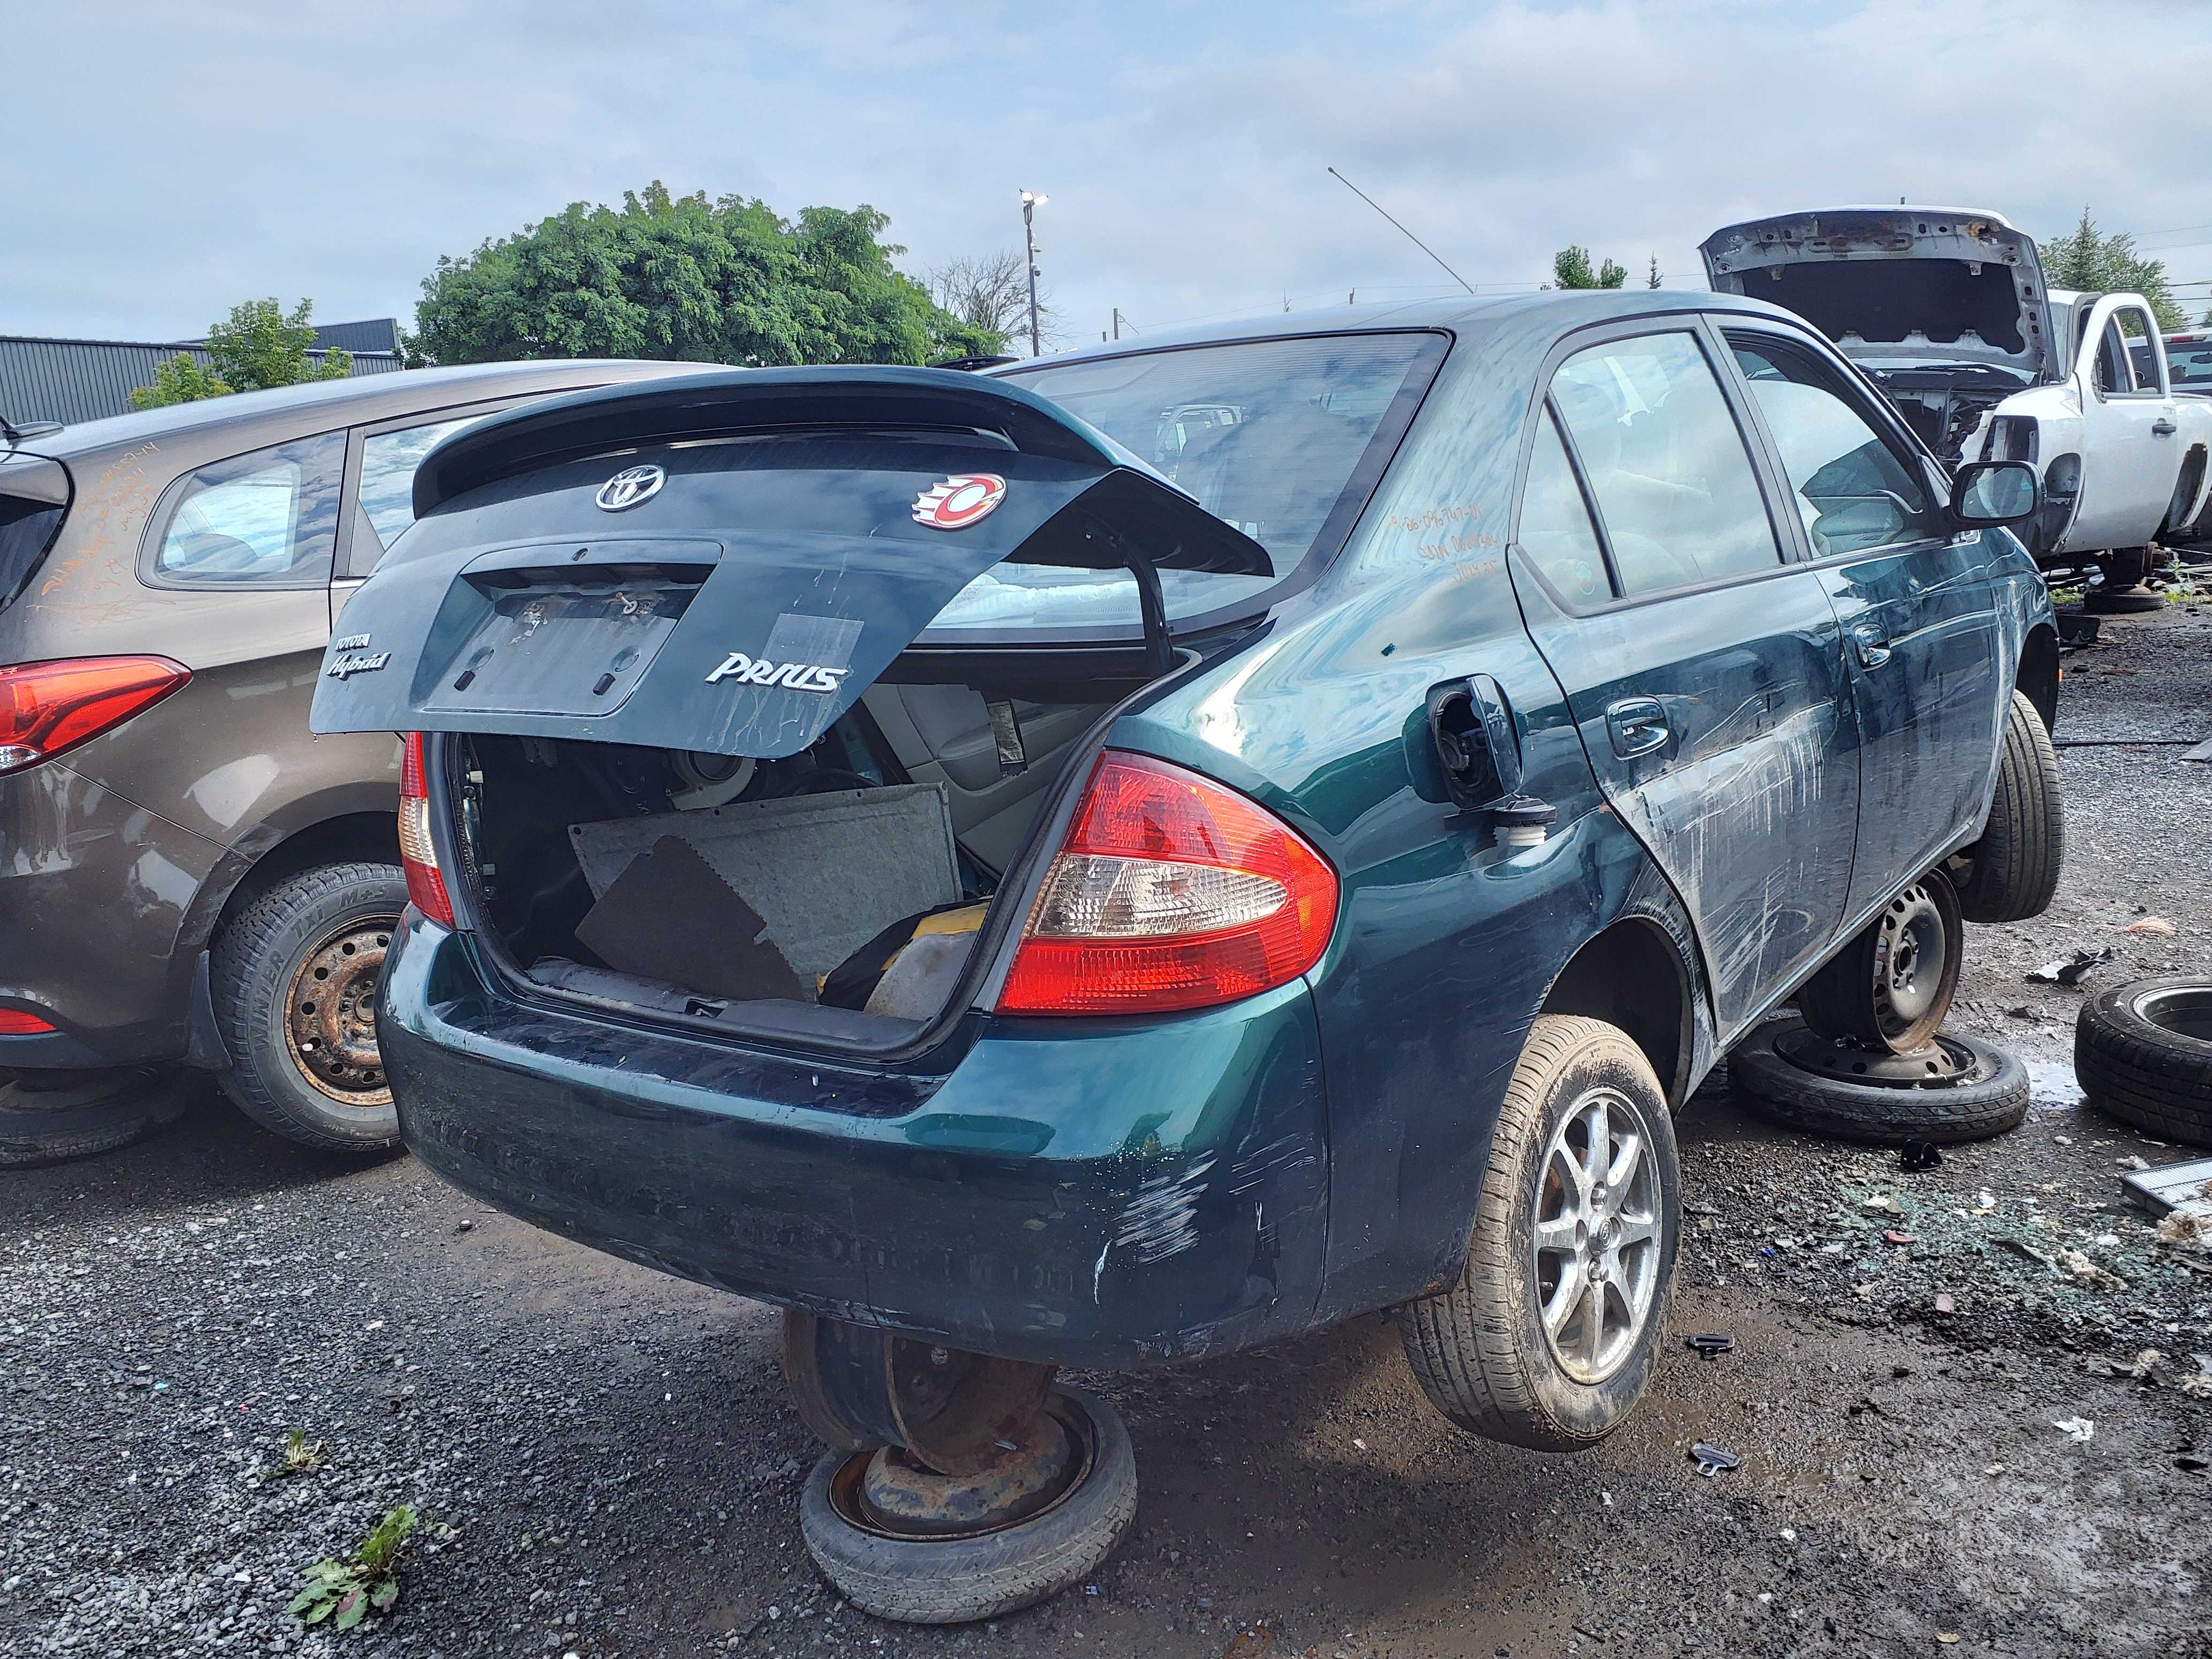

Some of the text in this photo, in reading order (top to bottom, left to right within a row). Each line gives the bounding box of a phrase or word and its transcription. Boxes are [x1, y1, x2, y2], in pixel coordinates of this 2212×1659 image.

[335, 633, 371, 652] TOYOTA
[326, 652, 392, 681] Hybrid
[704, 652, 849, 693] PRIUS
[250, 950, 285, 1050] WINTER
[339, 884, 388, 909] M+S
